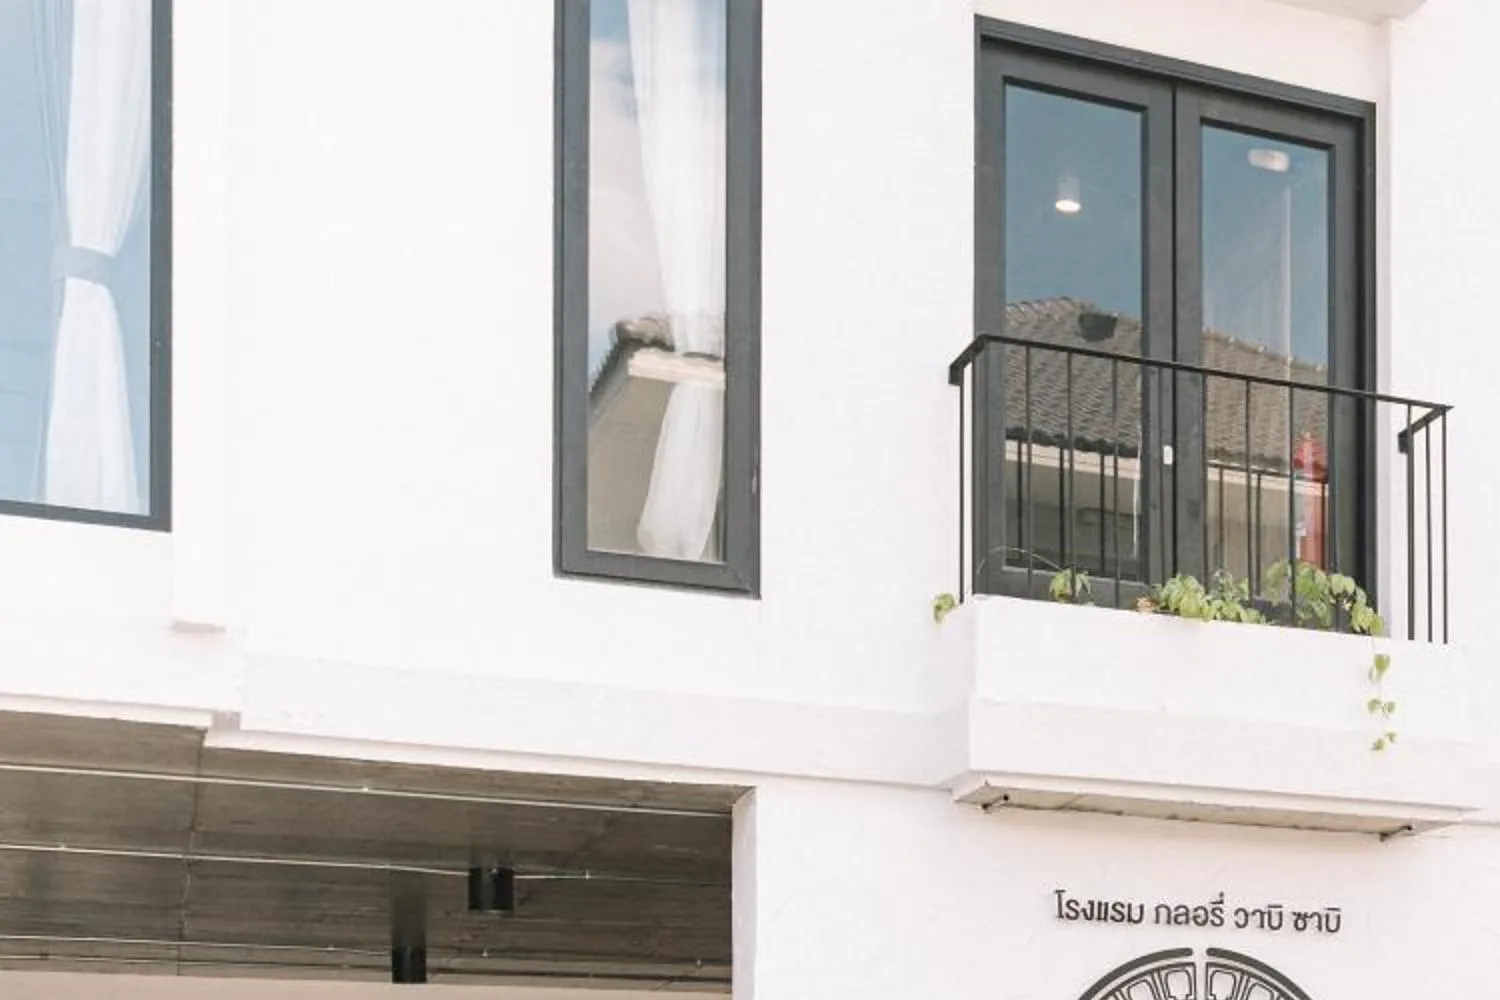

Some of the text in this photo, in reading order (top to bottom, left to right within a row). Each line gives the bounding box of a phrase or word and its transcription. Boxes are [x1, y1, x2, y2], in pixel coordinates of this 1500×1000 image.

[1054, 889, 1145, 925] โรงแรม
[1154, 890, 1225, 928] กลอรี่
[1233, 904, 1284, 931] วาบิ
